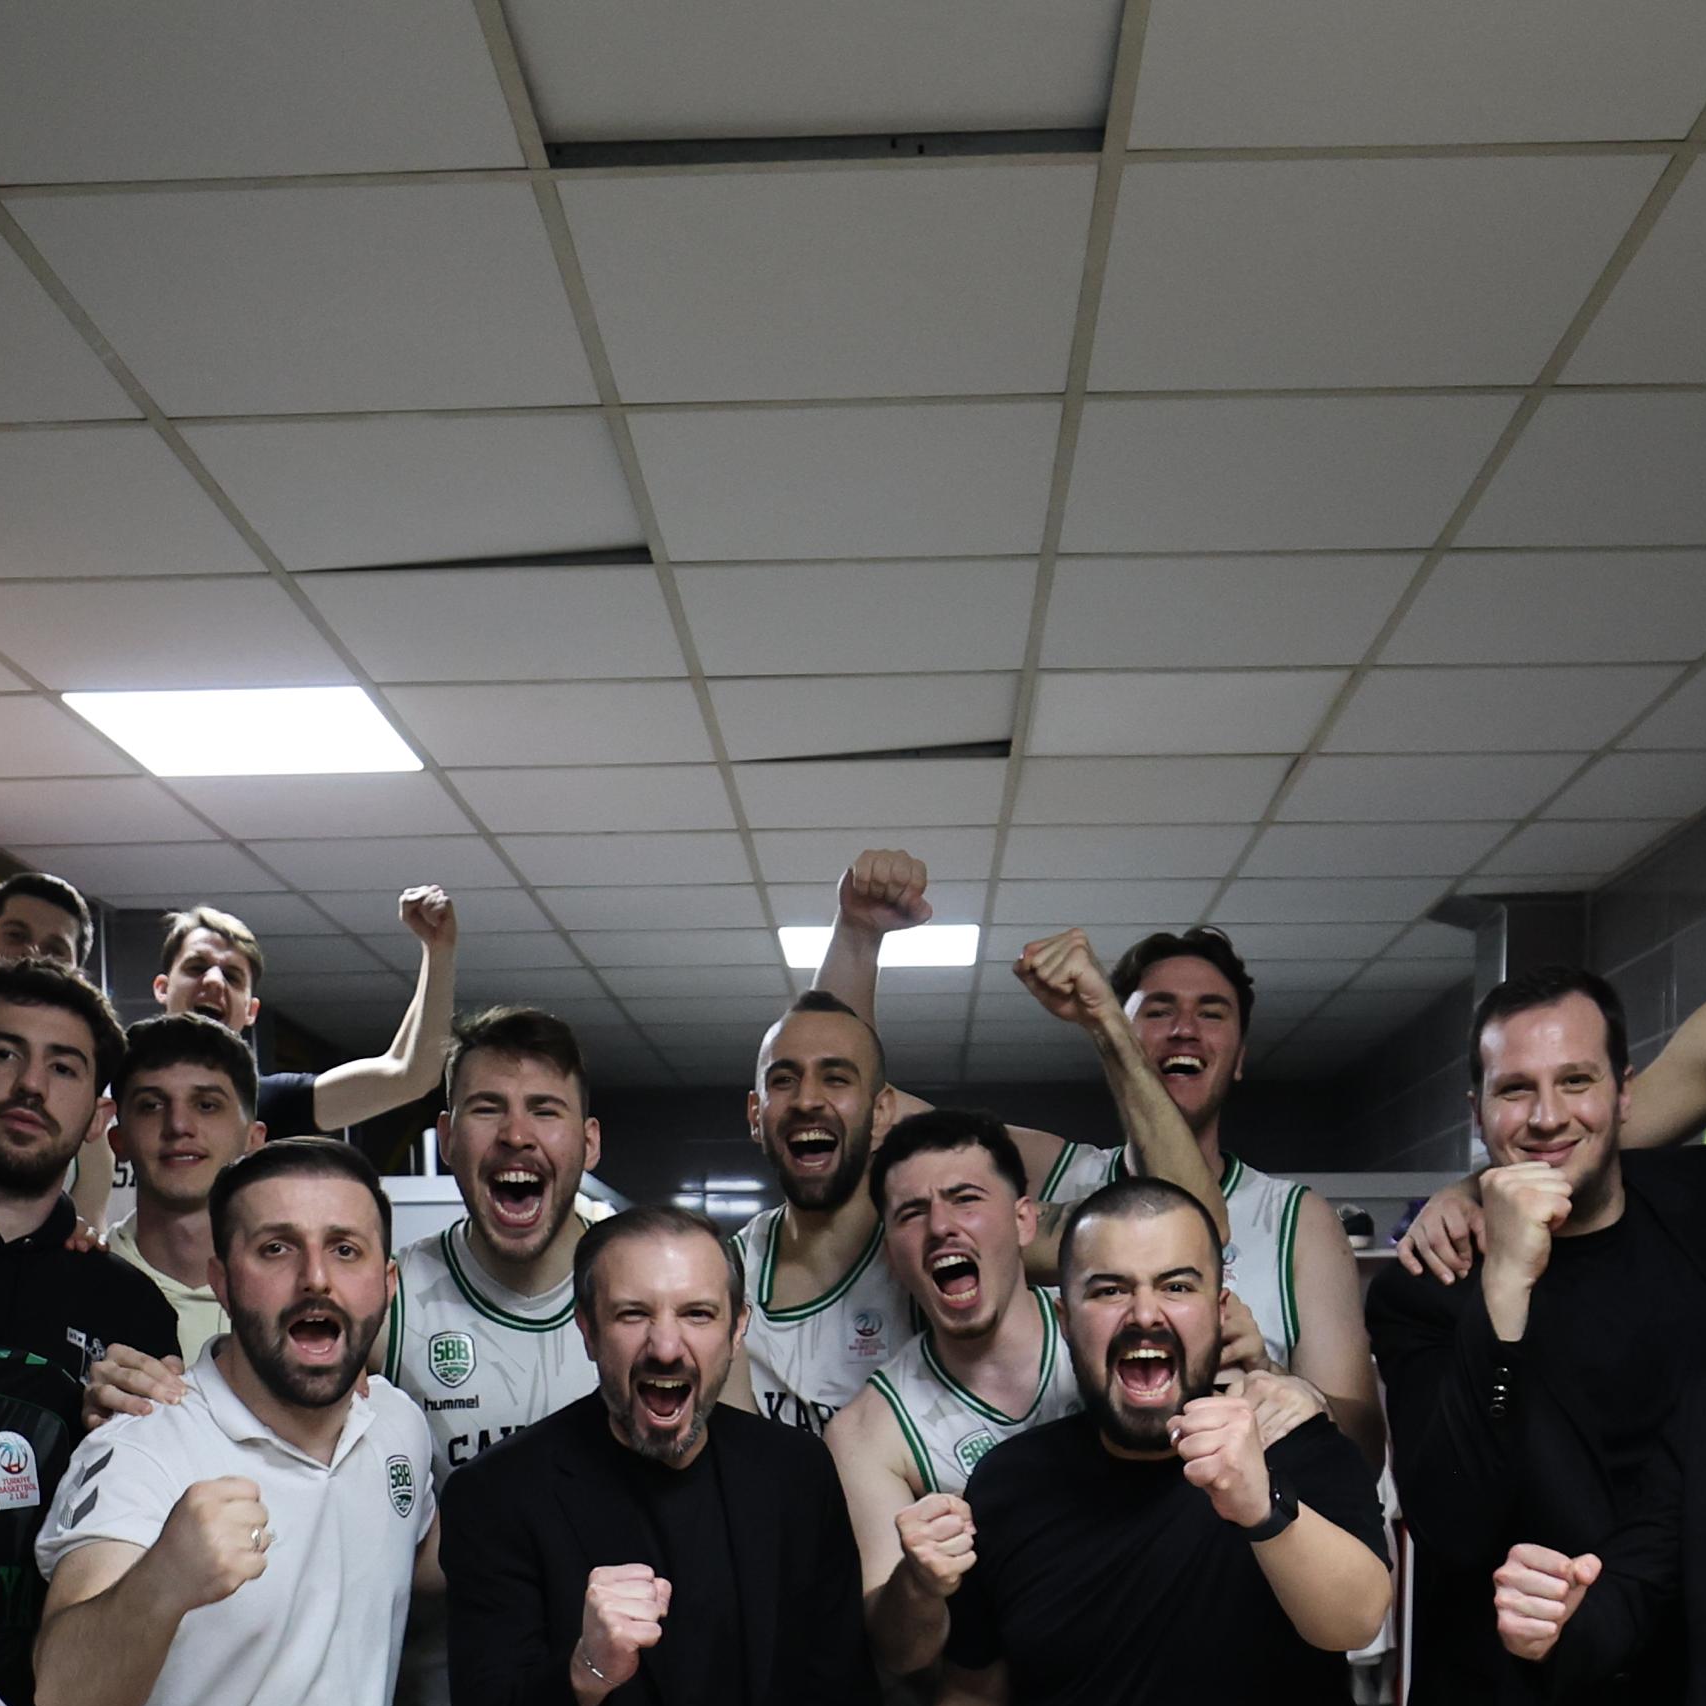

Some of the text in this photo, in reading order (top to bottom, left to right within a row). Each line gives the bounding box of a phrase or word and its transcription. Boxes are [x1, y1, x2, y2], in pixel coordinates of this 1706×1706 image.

[434, 1340, 471, 1362] SBB
[424, 1394, 480, 1412] hummel
[389, 1463, 413, 1489] SBB
